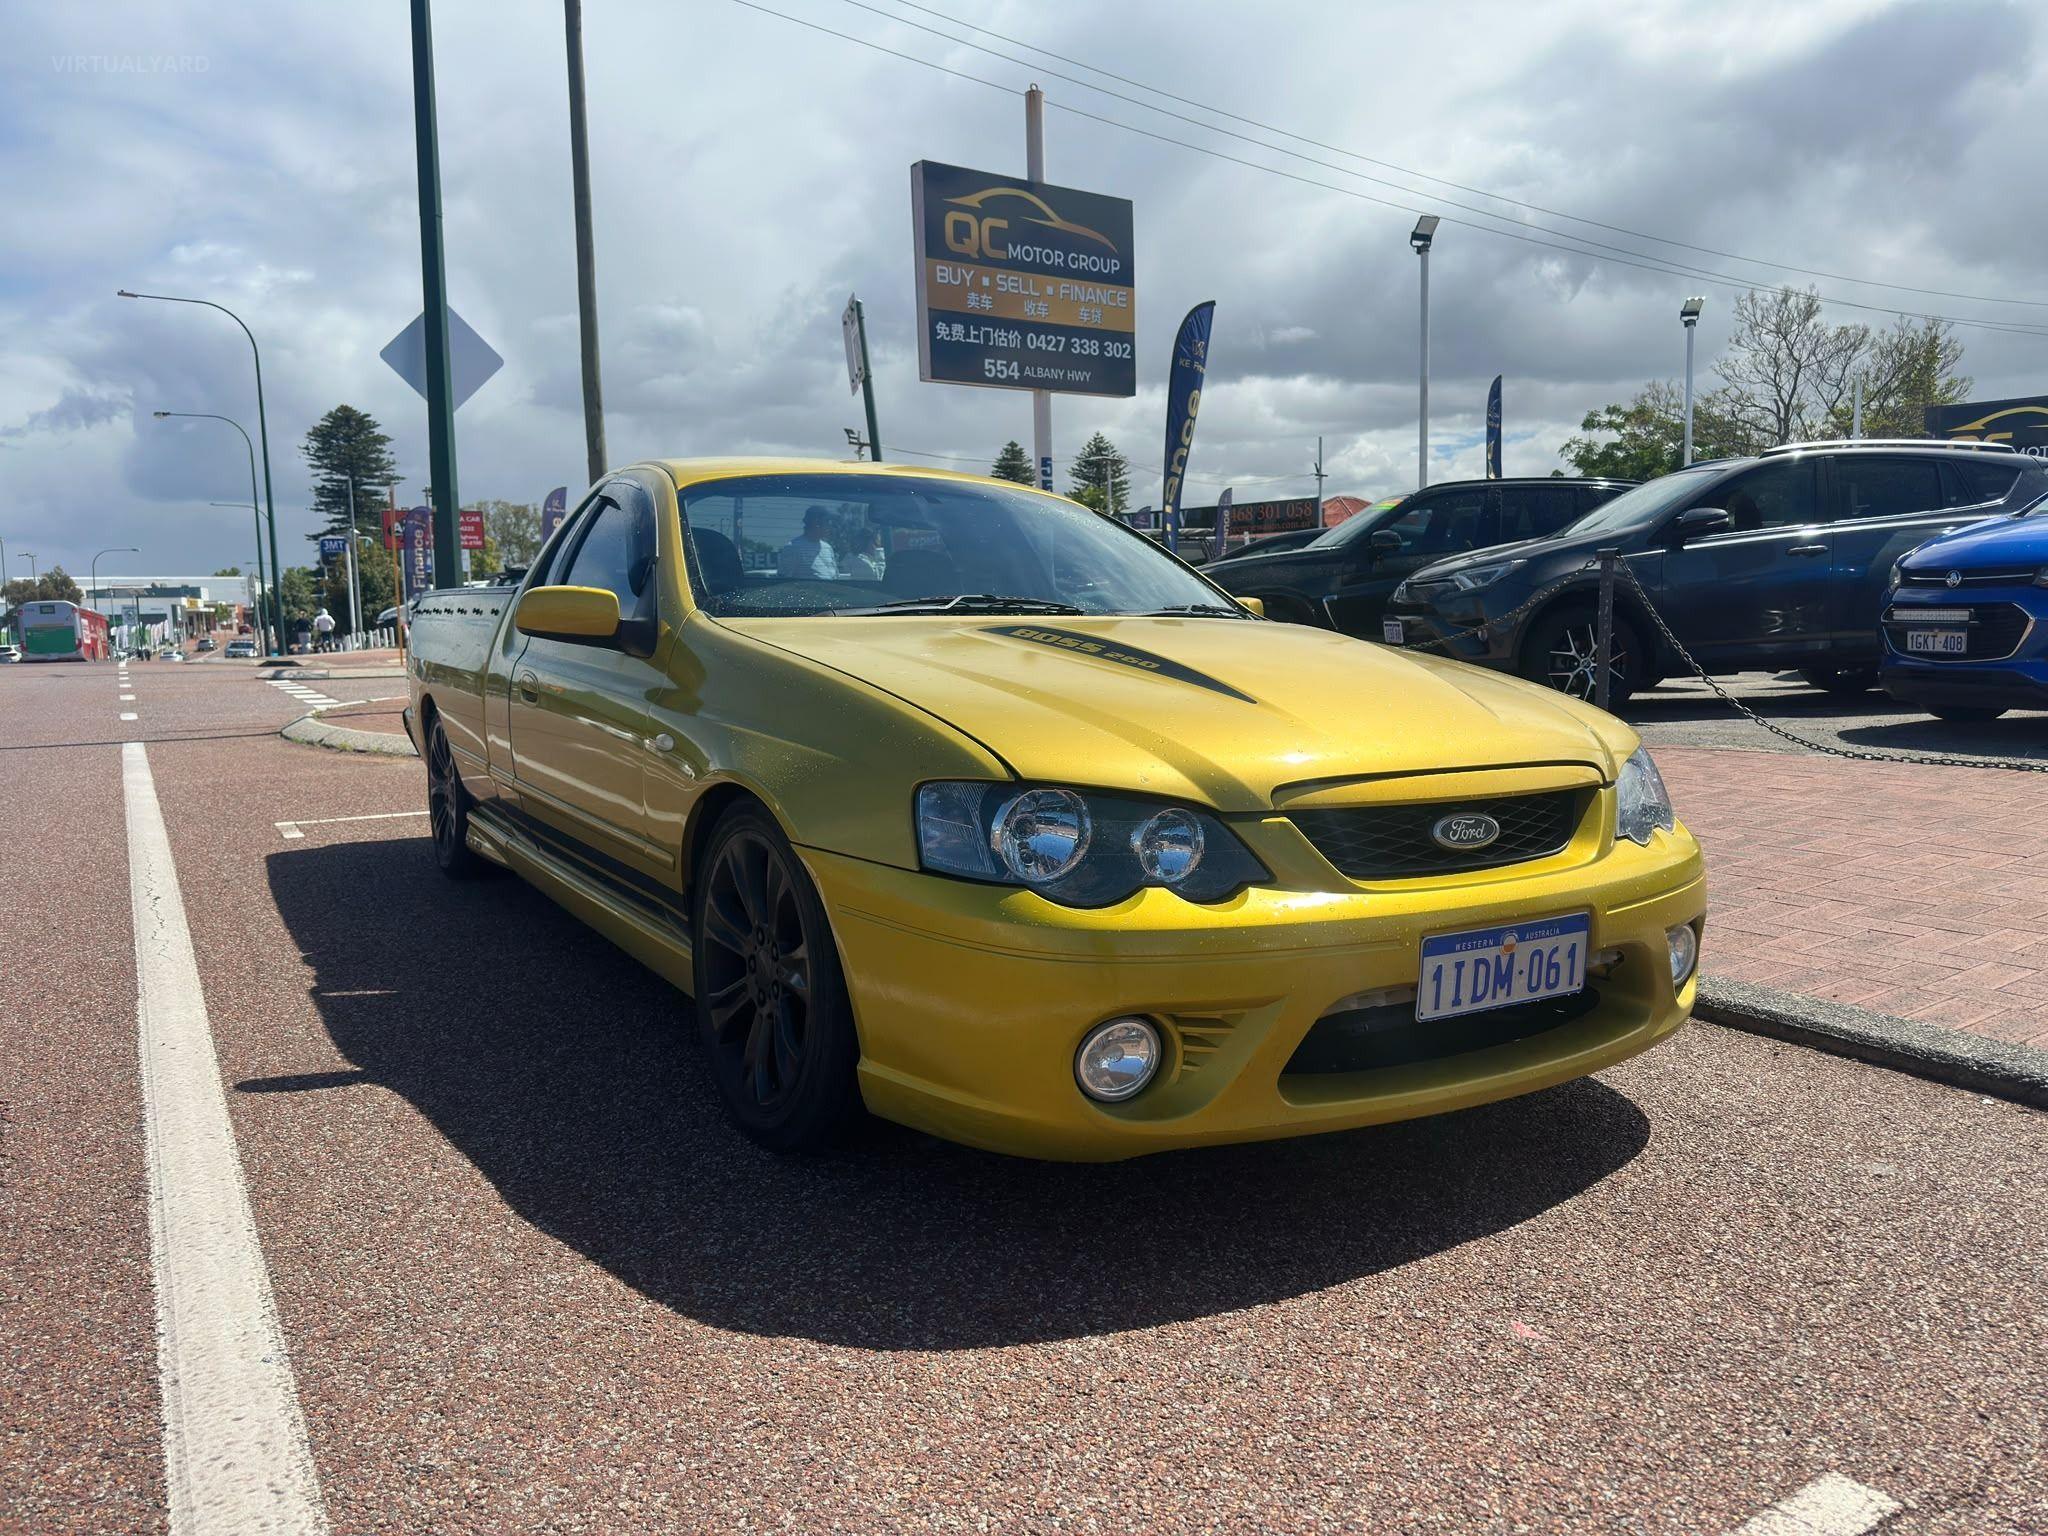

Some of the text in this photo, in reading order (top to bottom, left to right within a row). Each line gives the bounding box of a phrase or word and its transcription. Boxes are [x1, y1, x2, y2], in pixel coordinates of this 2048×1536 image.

[944, 210, 1120, 275] QC MOTOR GROUP
[936, 265, 1128, 307] BUY SELL FINANCE
[967, 292, 993, 310] 卖车
[1024, 301, 1049, 318] 收车
[935, 321, 1022, 349] 免费上门估价
[1027, 332, 1132, 359] 0427 338 302
[984, 358, 1091, 383] 554 ALBANY HWY
[412, 529, 427, 589] Finance
[1010, 628, 1161, 669] BOSS 260
[1449, 818, 1487, 841] Ford
[1455, 927, 1560, 952] WESTERN AUSTRALIA
